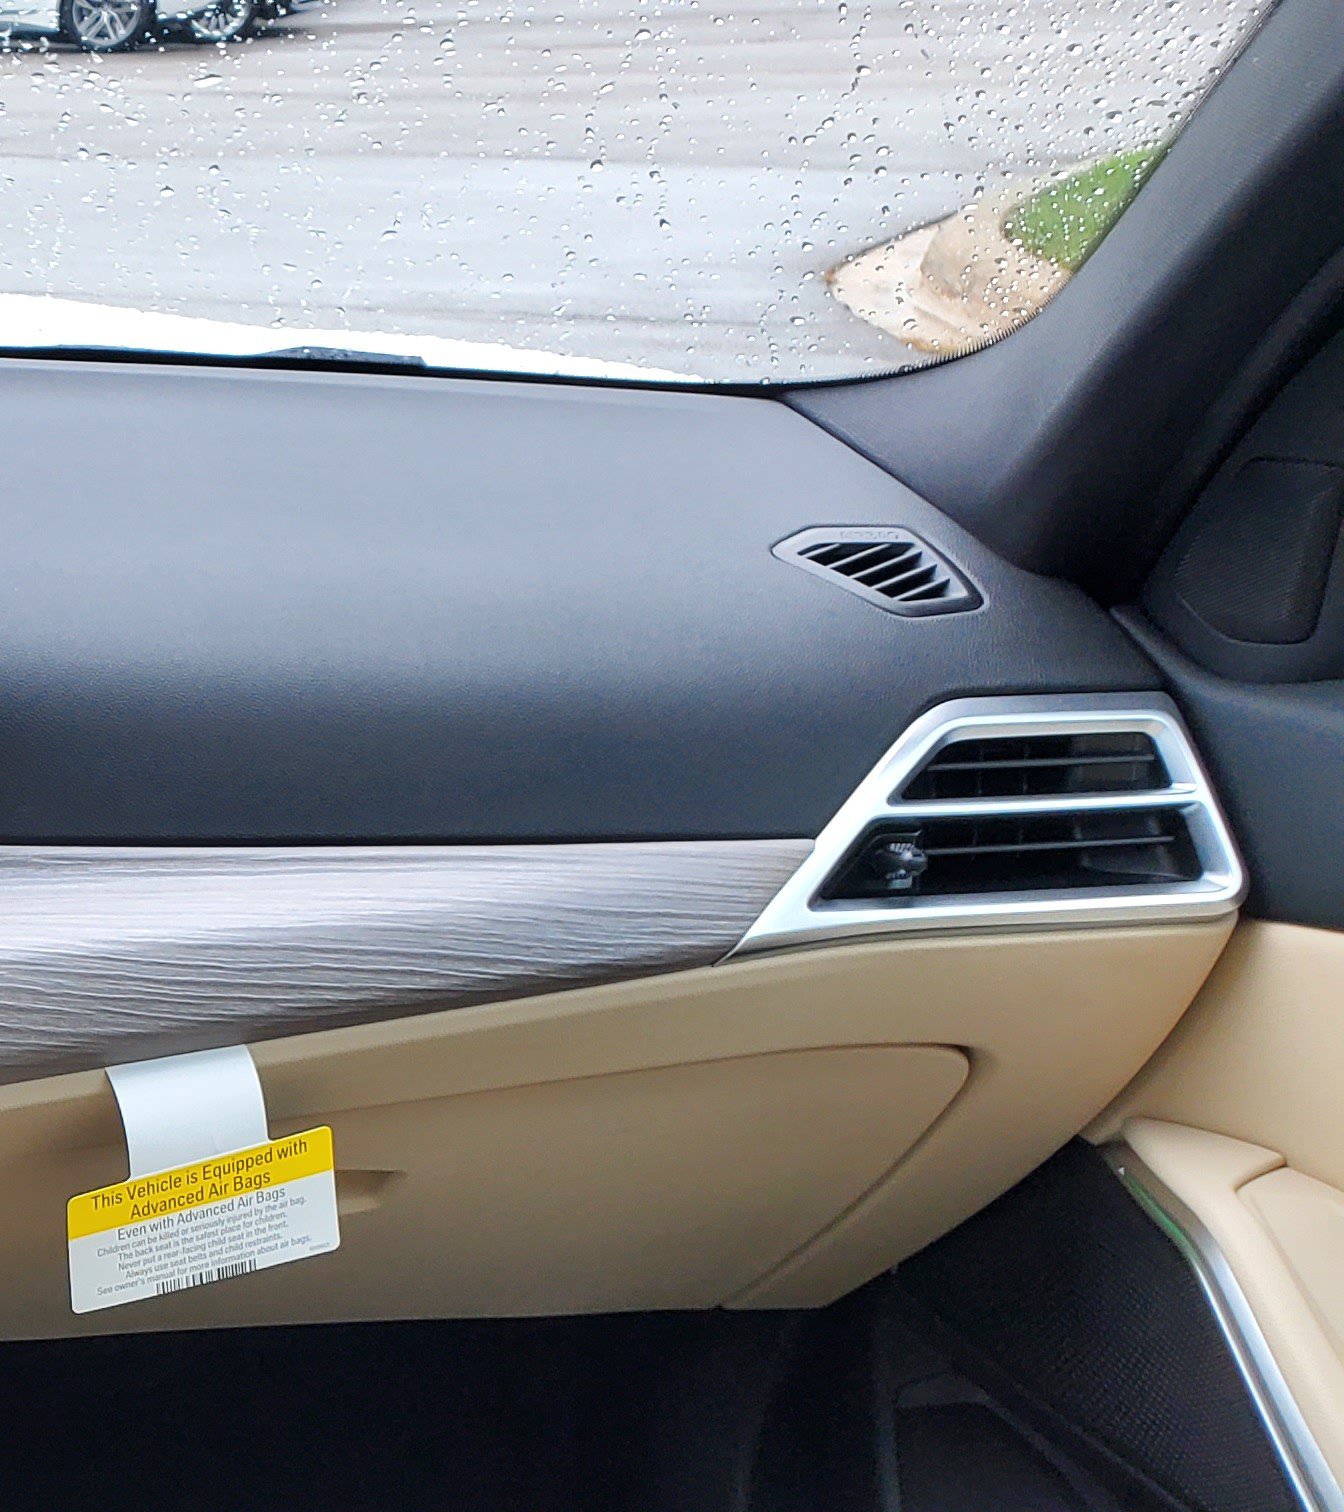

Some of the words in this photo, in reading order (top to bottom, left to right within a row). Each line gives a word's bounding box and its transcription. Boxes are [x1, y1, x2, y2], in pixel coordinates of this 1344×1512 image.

[91, 1190, 123, 1210] This
[126, 1174, 182, 1201] Vehicle
[186, 1170, 198, 1185] is
[202, 1149, 274, 1180] Equipped
[276, 1138, 308, 1160] with
[130, 1186, 204, 1220] Advanced
[208, 1181, 230, 1199] Air
[233, 1171, 271, 1193] Bags
[97, 1240, 131, 1258] Children
[131, 1237, 146, 1248] can
[158, 1229, 180, 1241] killed
[190, 1217, 225, 1234] seriously
[226, 1209, 253, 1225] injured
[265, 1203, 278, 1213] the
[279, 1199, 288, 1208] air
[289, 1196, 307, 1207] bag.
[117, 1225, 146, 1241] Even
[149, 1216, 174, 1233] with
[177, 1200, 235, 1225] Advanced
[237, 1195, 253, 1210] Air
[256, 1187, 286, 1204] Bags
[118, 1251, 133, 1261] The
[135, 1246, 153, 1257] back
[155, 1240, 172, 1250] seat
[181, 1235, 194, 1245] the
[195, 1229, 219, 1242] safest
[220, 1223, 241, 1237] place
[243, 1219, 253, 1230] for
[254, 1211, 287, 1226] children.
[97, 1286, 113, 1296] See
[114, 1277, 145, 1292] owner's
[146, 1270, 176, 1284] manual
[177, 1266, 188, 1276] for
[189, 1262, 210, 1272] more
[210, 1250, 255, 1269] information
[256, 1242, 279, 1255] about
[280, 1240, 289, 1249] air
[291, 1234, 312, 1247] bags.
[118, 1259, 141, 1272] Never
[142, 1255, 156, 1267] put
[163, 1243, 207, 1260] rear-facing
[208, 1236, 226, 1249] child
[228, 1233, 245, 1244] seat
[254, 1225, 267, 1236] the
[268, 1220, 289, 1233] front.
[125, 1267, 153, 1280] Always
[154, 1262, 169, 1272] use
[170, 1256, 187, 1267] seat
[188, 1251, 207, 1264] belts
[208, 1247, 224, 1257] and
[224, 1242, 244, 1254] child
[244, 1232, 283, 1248] restraints.
